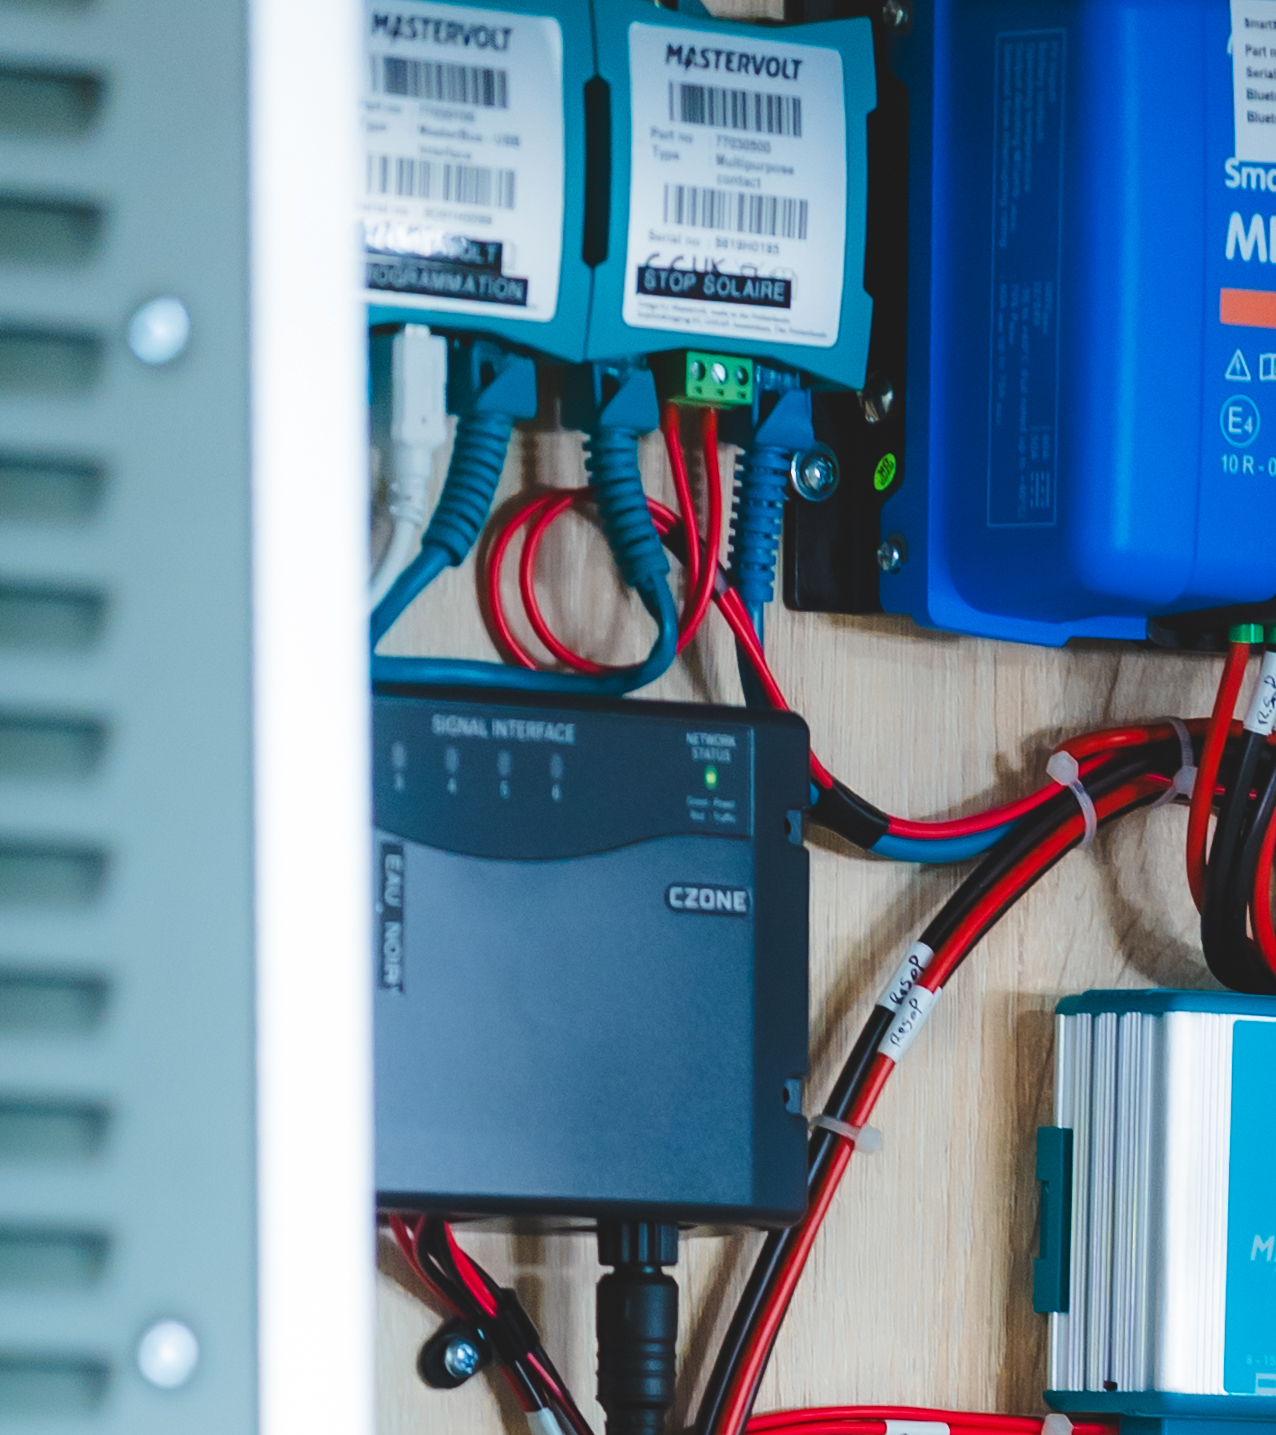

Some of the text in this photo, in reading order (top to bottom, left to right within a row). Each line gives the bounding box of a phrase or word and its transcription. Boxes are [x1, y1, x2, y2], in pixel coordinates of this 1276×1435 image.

[372, 12, 513, 51] MASTERVOLT
[665, 43, 802, 81] MASTERVOLT
[1245, 44, 1266, 58] Part
[1246, 66, 1276, 79] Serial
[644, 269, 785, 301] STOP SOLAIRE
[1221, 454, 1239, 474] 10
[1243, 456, 1254, 475] R
[431, 713, 576, 746] SIGNAL INTERFACE
[669, 886, 747, 912] CZONE
